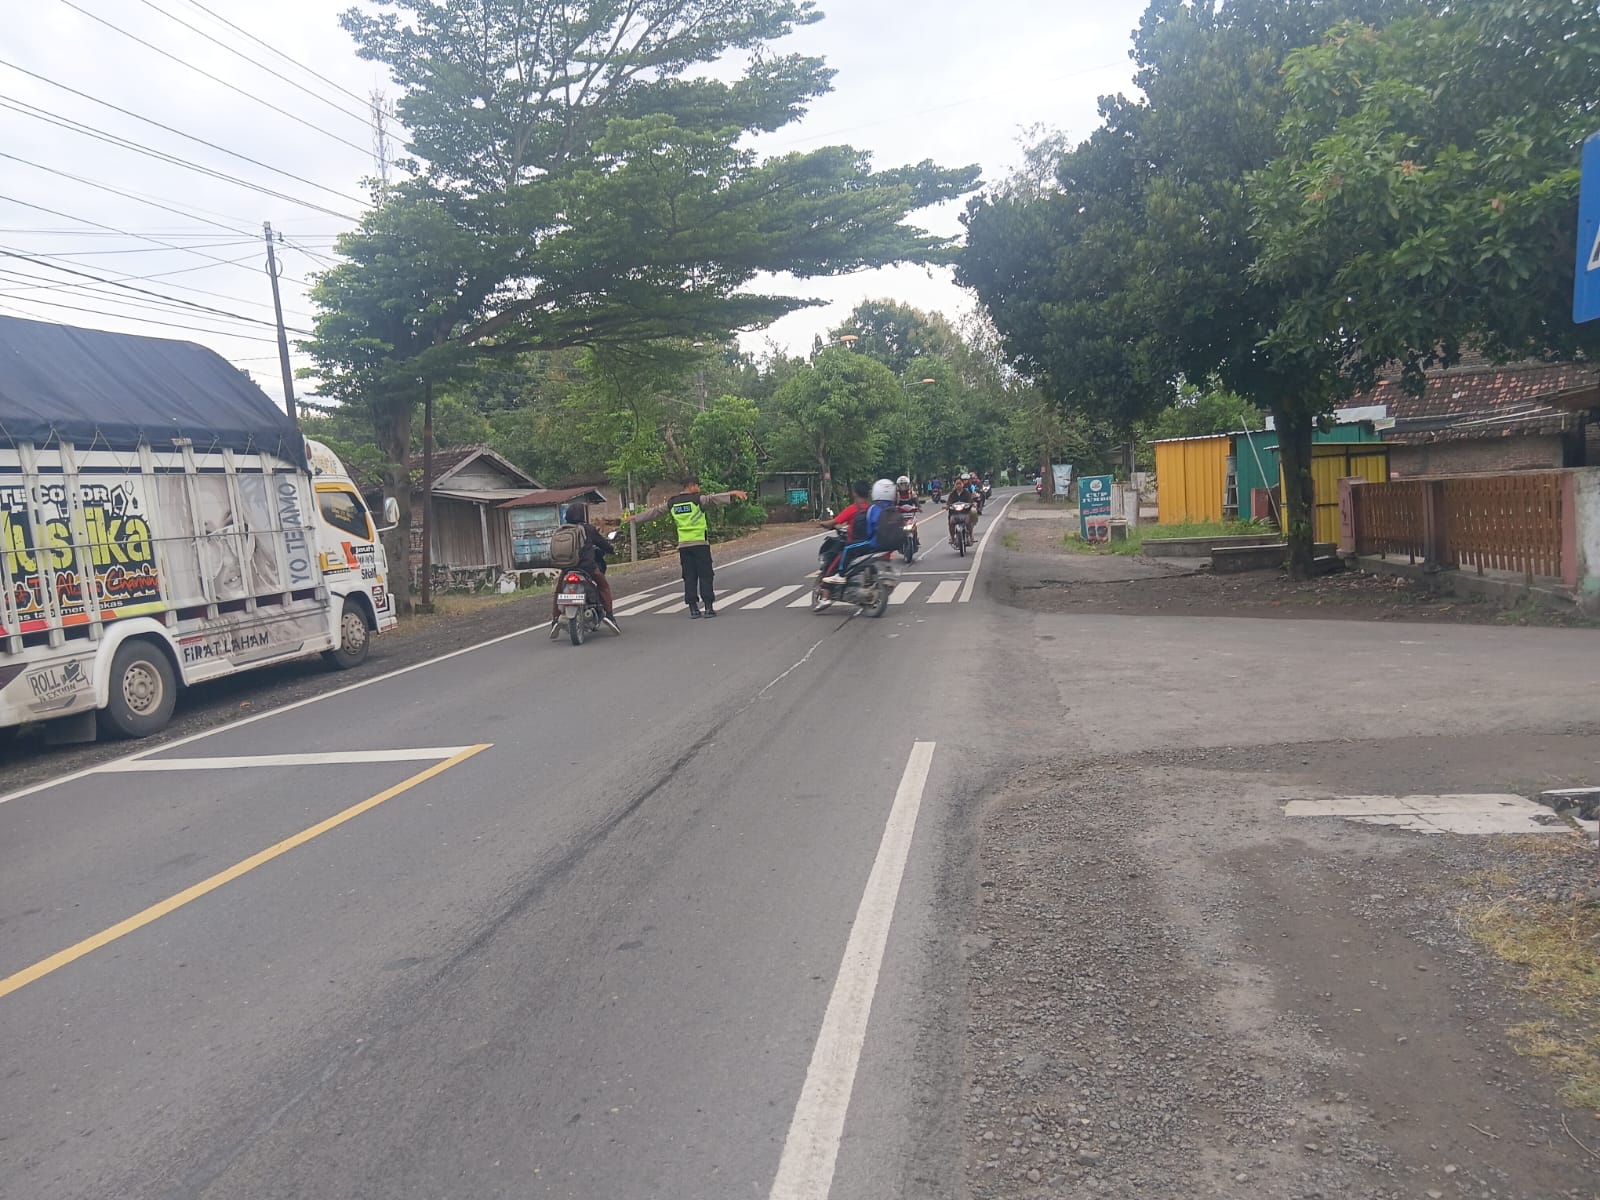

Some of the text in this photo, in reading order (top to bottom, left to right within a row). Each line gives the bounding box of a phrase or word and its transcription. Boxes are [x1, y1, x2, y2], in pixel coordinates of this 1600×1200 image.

[32, 486, 108, 503] COOR
[289, 559, 310, 584] YO
[224, 631, 269, 654] LAHAM
[29, 669, 61, 697] ROLL
